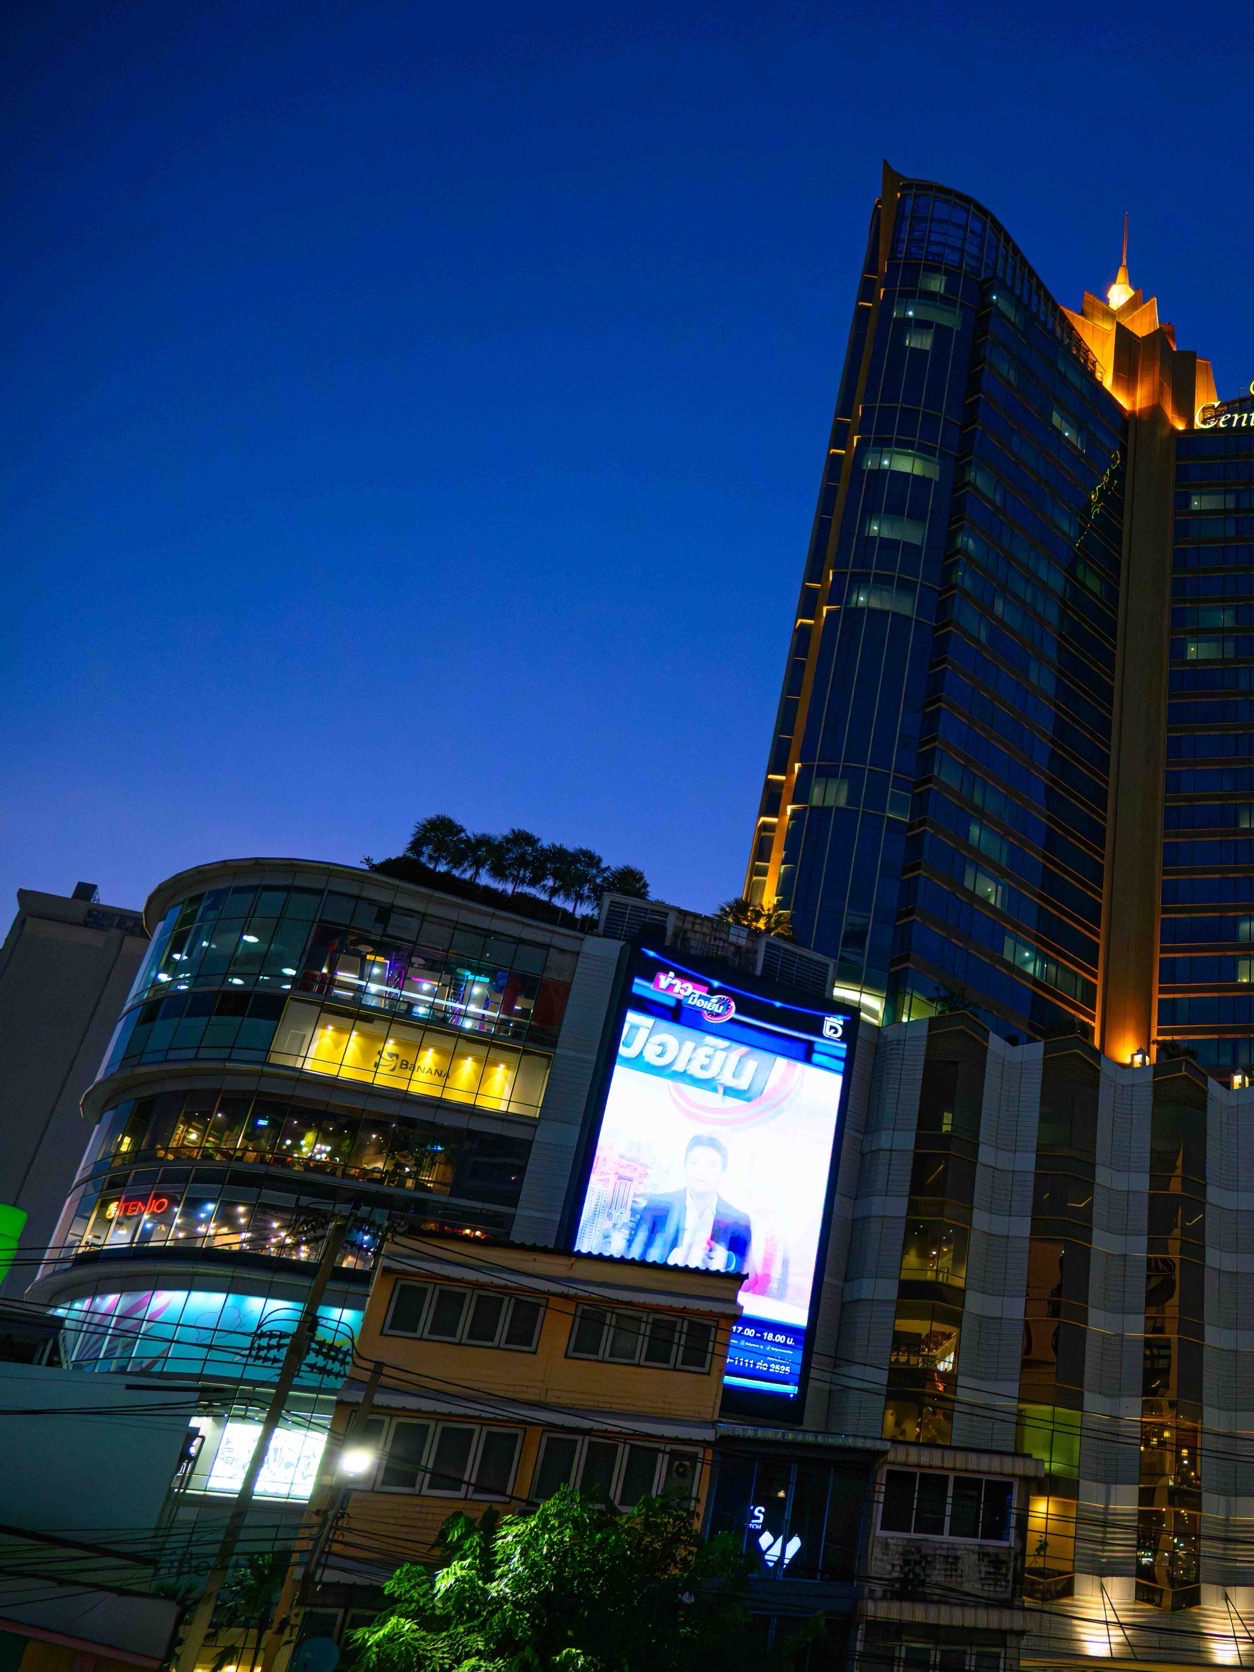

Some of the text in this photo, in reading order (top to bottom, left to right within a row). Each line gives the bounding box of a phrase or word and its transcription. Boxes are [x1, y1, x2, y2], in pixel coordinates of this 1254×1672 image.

[658, 971, 693, 996] ข่าว
[732, 1326, 755, 1337] 17.00
[763, 1332, 786, 1343] 18.00
